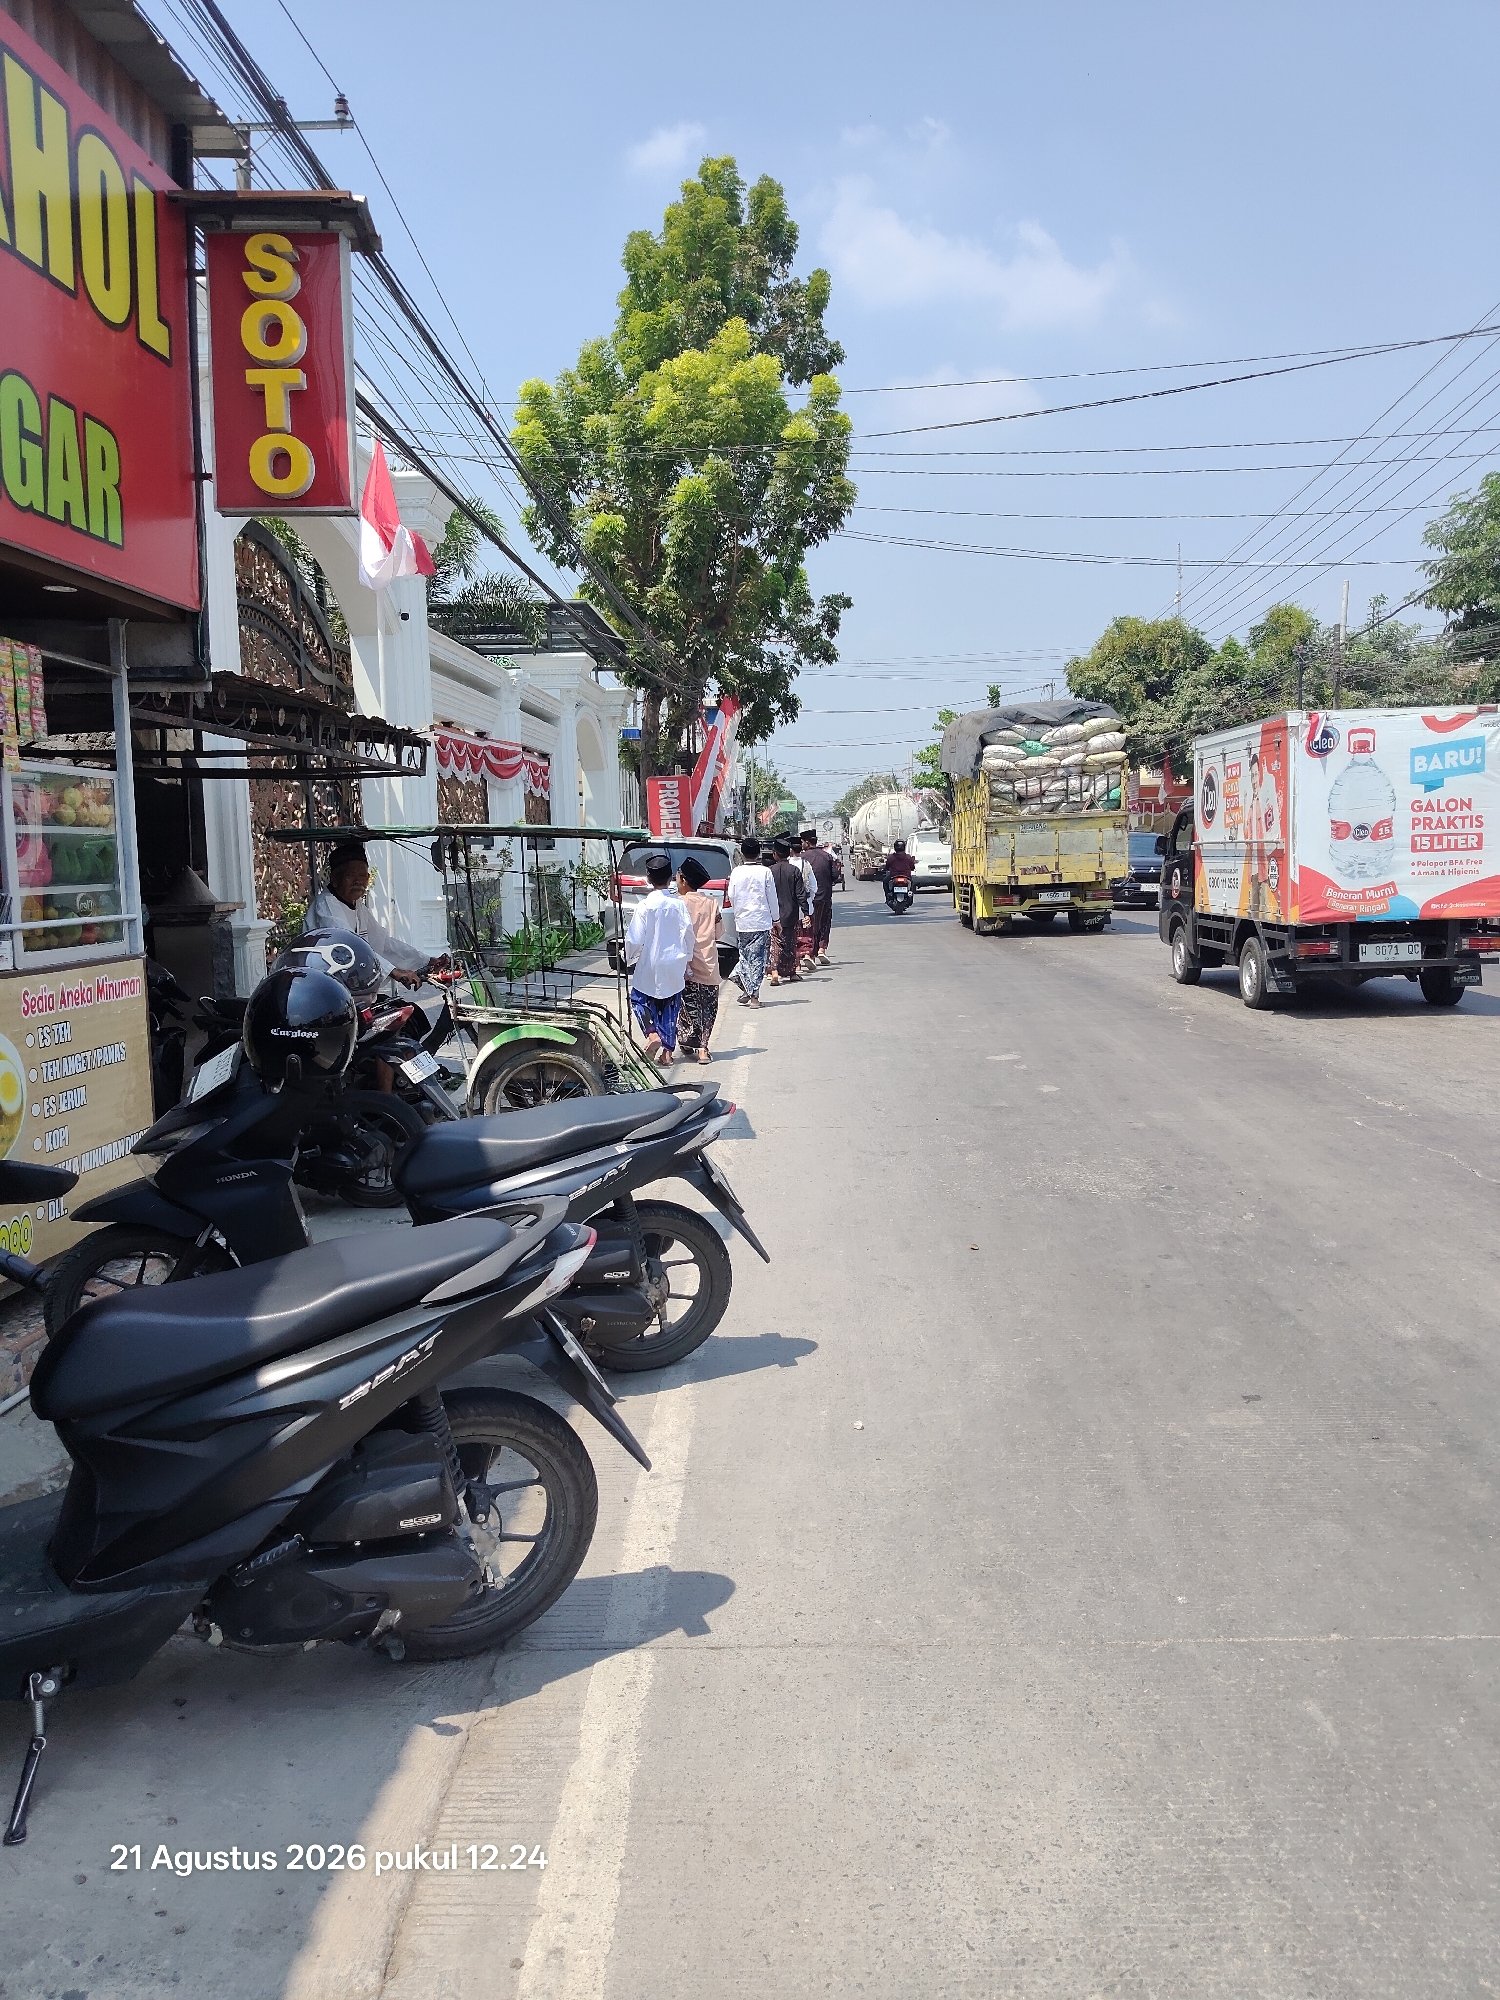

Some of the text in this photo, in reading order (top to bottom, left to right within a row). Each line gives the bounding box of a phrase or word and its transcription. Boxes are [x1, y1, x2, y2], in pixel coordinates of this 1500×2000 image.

[0, 52, 173, 366] HOL
[240, 233, 314, 499] SOTO
[0, 369, 123, 549] GAR
[1414, 747, 1482, 773] BARU!
[658, 780, 682, 837] PROMED
[1410, 797, 1473, 813] GALON
[1411, 815, 1485, 831] PRAKTIS
[1414, 835, 1479, 850] 15 LITER
[1448, 867, 1480, 876] Higienis
[1326, 885, 1395, 901] Beneran Murni
[1359, 902, 1387, 914] Ringan
[22, 974, 141, 1018] Sedia Aneka Minuman
[37, 1021, 72, 1049] ES TEH
[41, 1058, 61, 1083] TEH
[43, 1085, 87, 1119] ES JERUK
[45, 1125, 70, 1153] KOPI
[81, 1137, 125, 1174] MINUMAN
[215, 1170, 259, 1184] HONDA
[339, 1329, 443, 1411] BEAT
